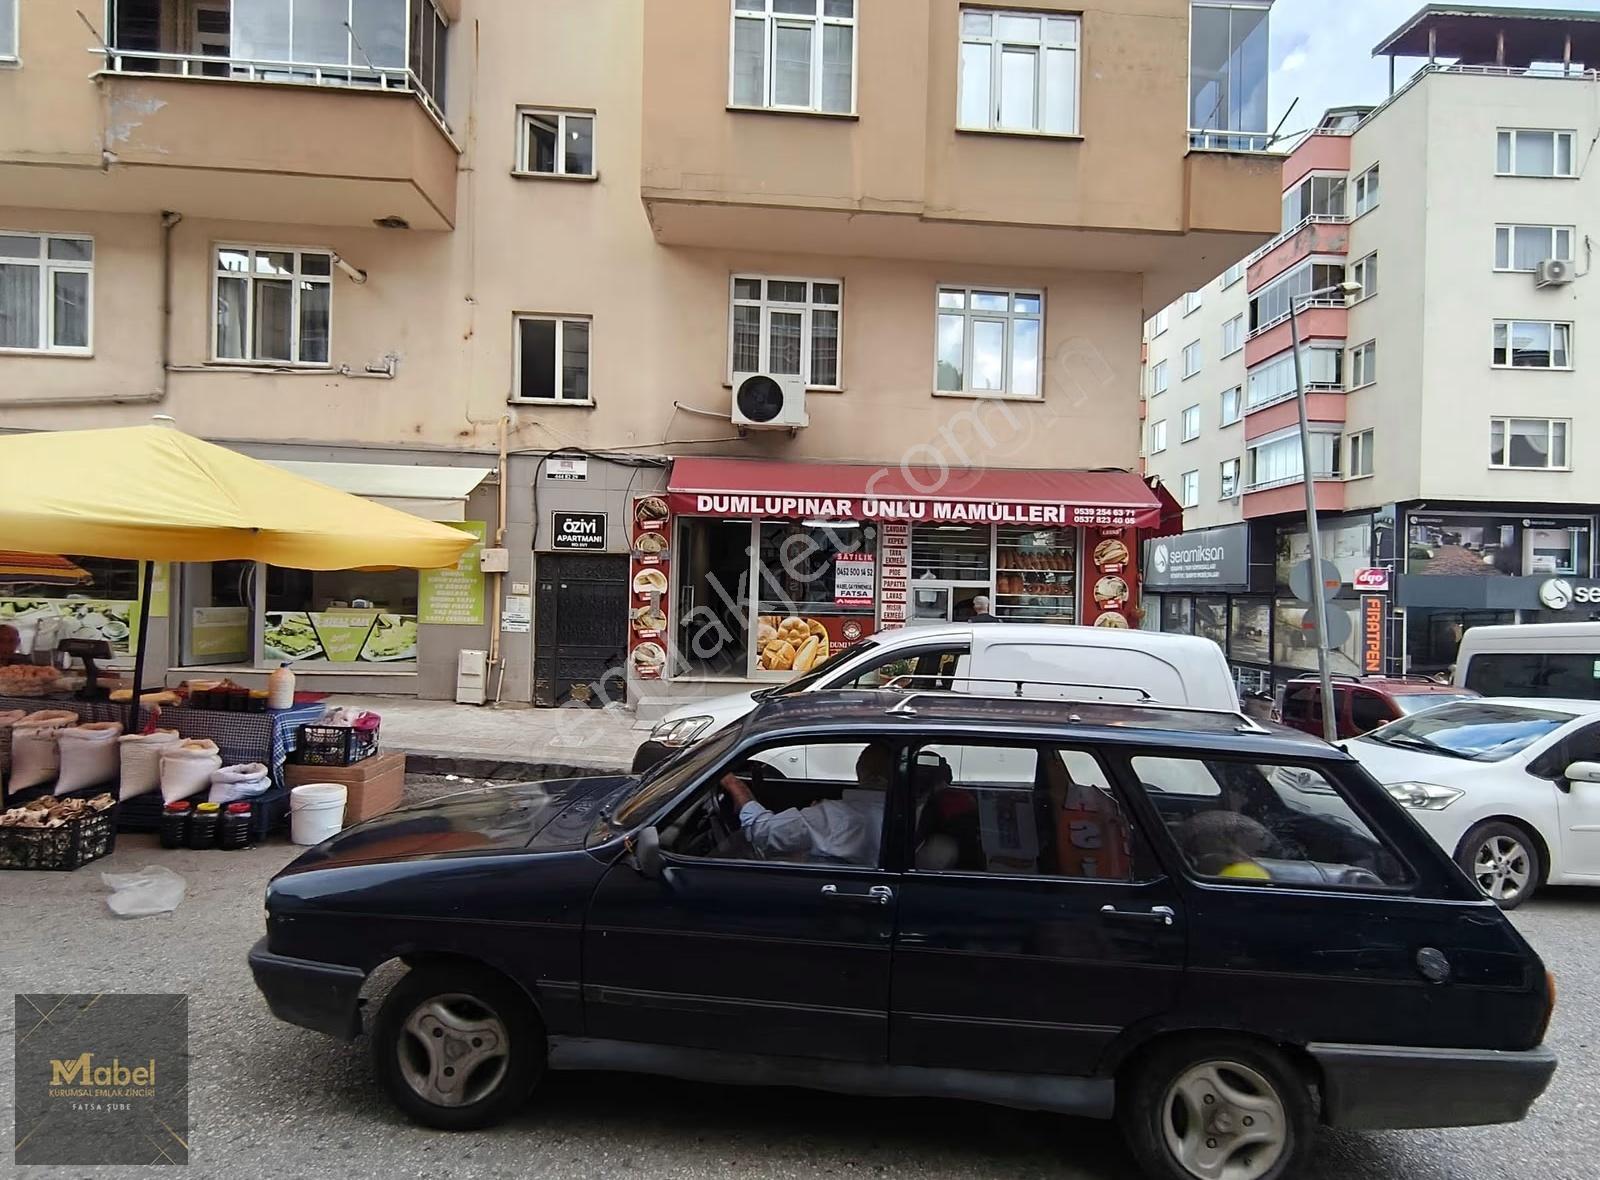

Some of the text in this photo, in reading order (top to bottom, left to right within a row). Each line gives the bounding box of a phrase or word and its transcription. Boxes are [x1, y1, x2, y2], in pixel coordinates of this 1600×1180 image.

[697, 495, 852, 516] DUMLUPINAR
[933, 501, 1066, 523] MAMÜLLERİ
[563, 518, 596, 534] ÖZİYİ
[557, 535, 602, 543] APARTMANI
[837, 553, 873, 561] SATILIK
[1169, 545, 1224, 564] seramiksan
[883, 580, 906, 588] PAPATYA
[1366, 598, 1381, 671] FIRATPEN
